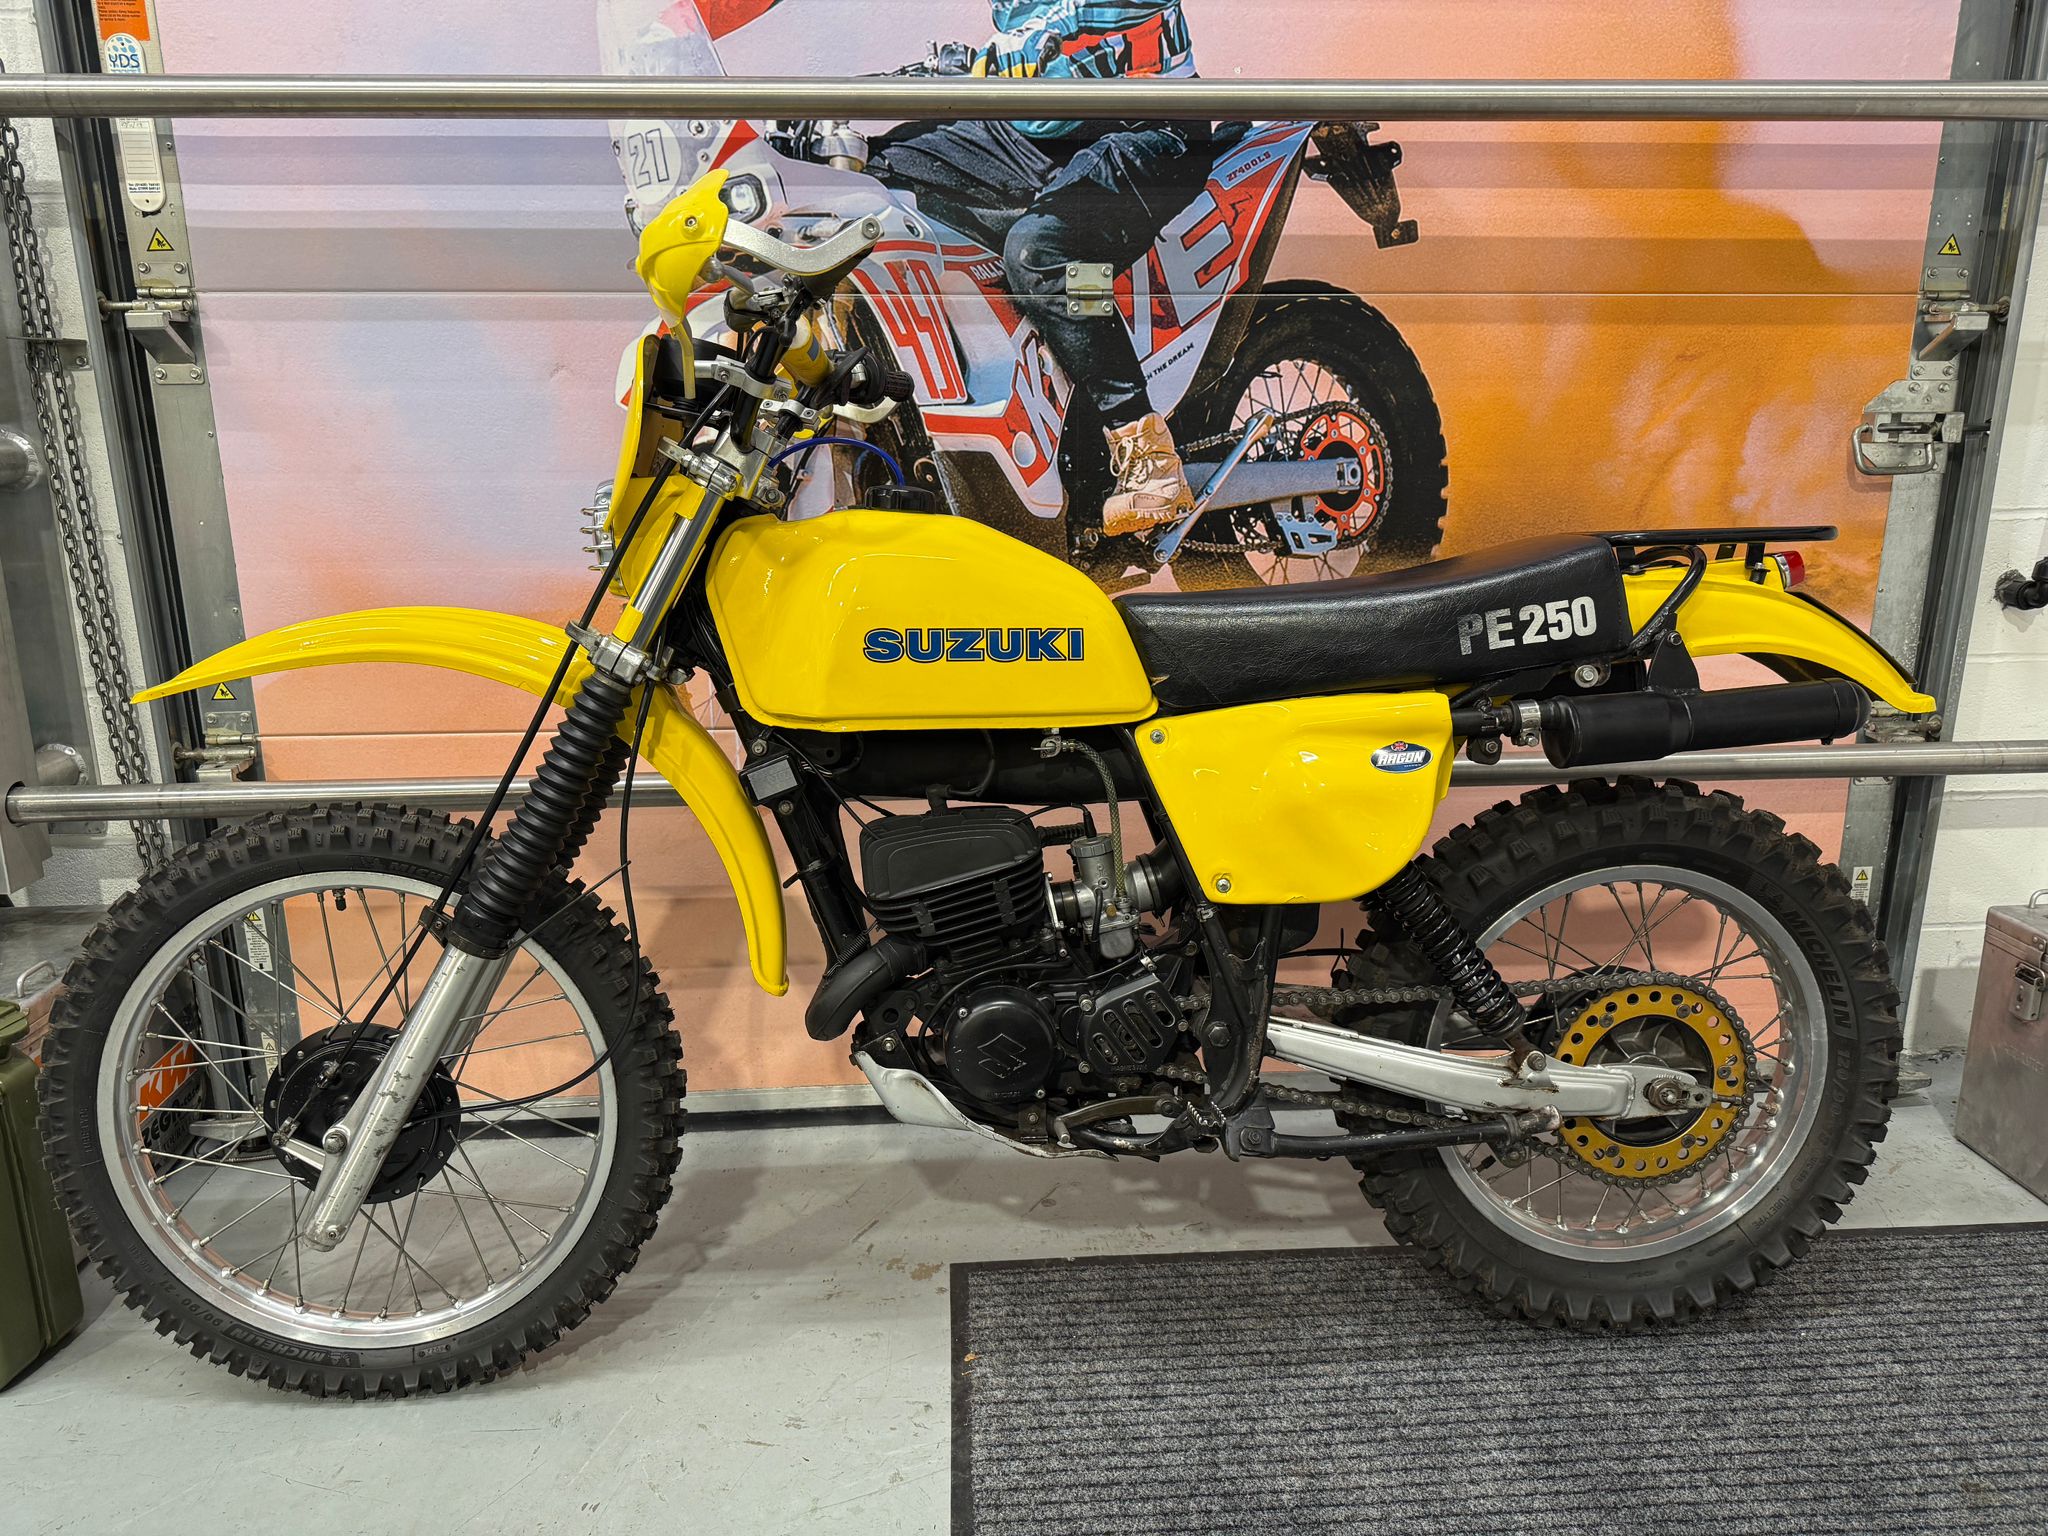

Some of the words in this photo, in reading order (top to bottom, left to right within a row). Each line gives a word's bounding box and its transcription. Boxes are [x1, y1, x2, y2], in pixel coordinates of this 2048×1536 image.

[108, 53, 140, 68] YDS
[627, 130, 670, 189] 21
[1153, 361, 1168, 376] THE
[1168, 341, 1195, 365] DREAM
[1457, 608, 1516, 656] PE
[1518, 595, 1597, 645] 250
[863, 628, 1085, 663] SUZUKI
[1781, 909, 1853, 1030] MICHELIN
[182, 1298, 223, 1328] 90/90
[230, 1326, 328, 1363] MICHELIN
